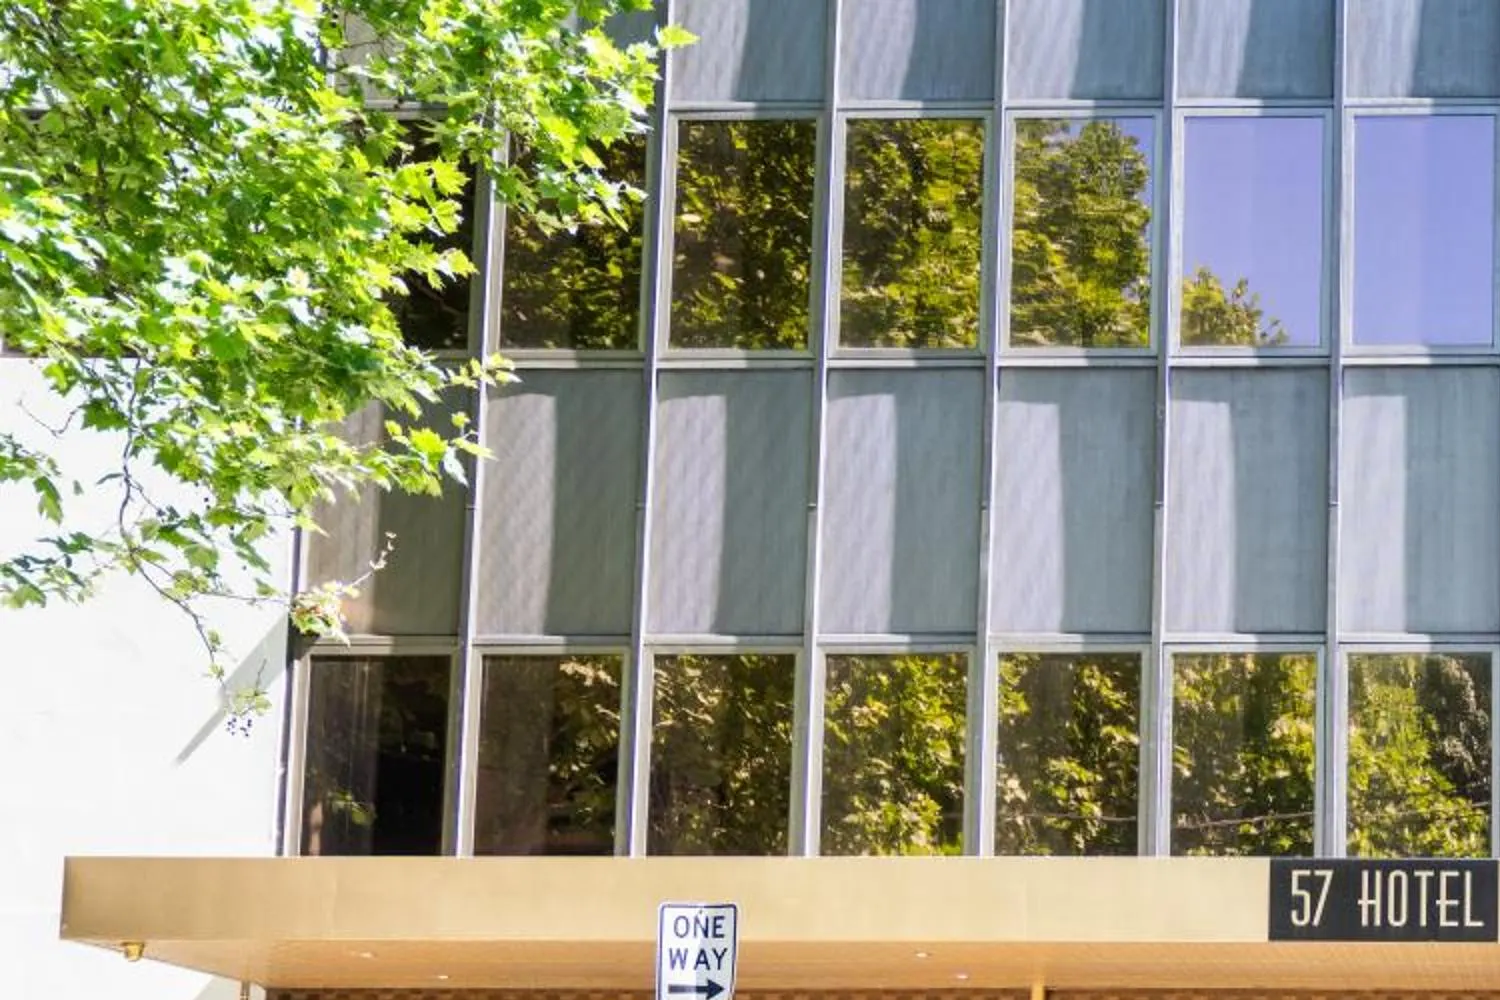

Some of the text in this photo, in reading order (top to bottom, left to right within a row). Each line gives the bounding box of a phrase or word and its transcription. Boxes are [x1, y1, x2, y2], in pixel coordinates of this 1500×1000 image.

[1290, 869, 1485, 927] 57 HOTEL
[673, 915, 725, 938] ONE
[669, 948, 728, 971] WAY
